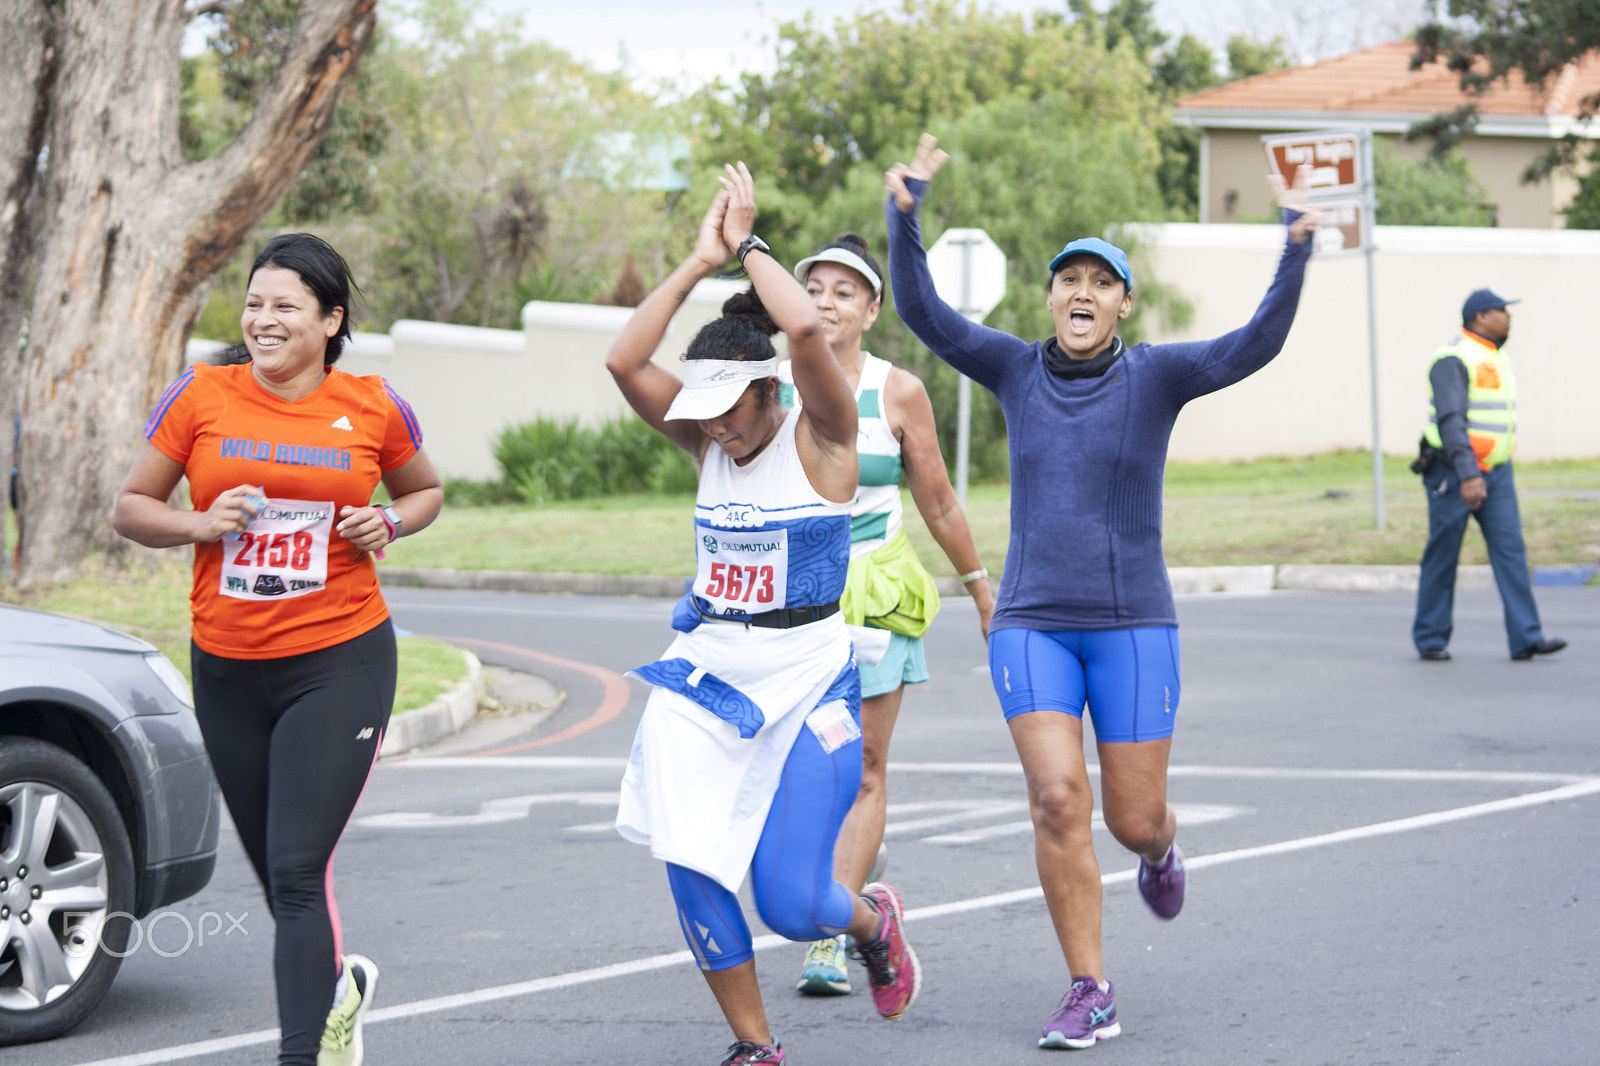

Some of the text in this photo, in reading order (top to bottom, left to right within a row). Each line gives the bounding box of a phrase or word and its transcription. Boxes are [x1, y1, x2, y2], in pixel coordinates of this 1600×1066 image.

[220, 438, 351, 471] WILD RUNNER
[261, 509, 329, 521] LDMUTUAL
[724, 511, 749, 522] AAC
[232, 531, 312, 571] 2158
[721, 541, 783, 553] OLDMUTUAL
[226, 576, 249, 593] WPA
[257, 577, 283, 588] ASA
[705, 562, 774, 604] 5673
